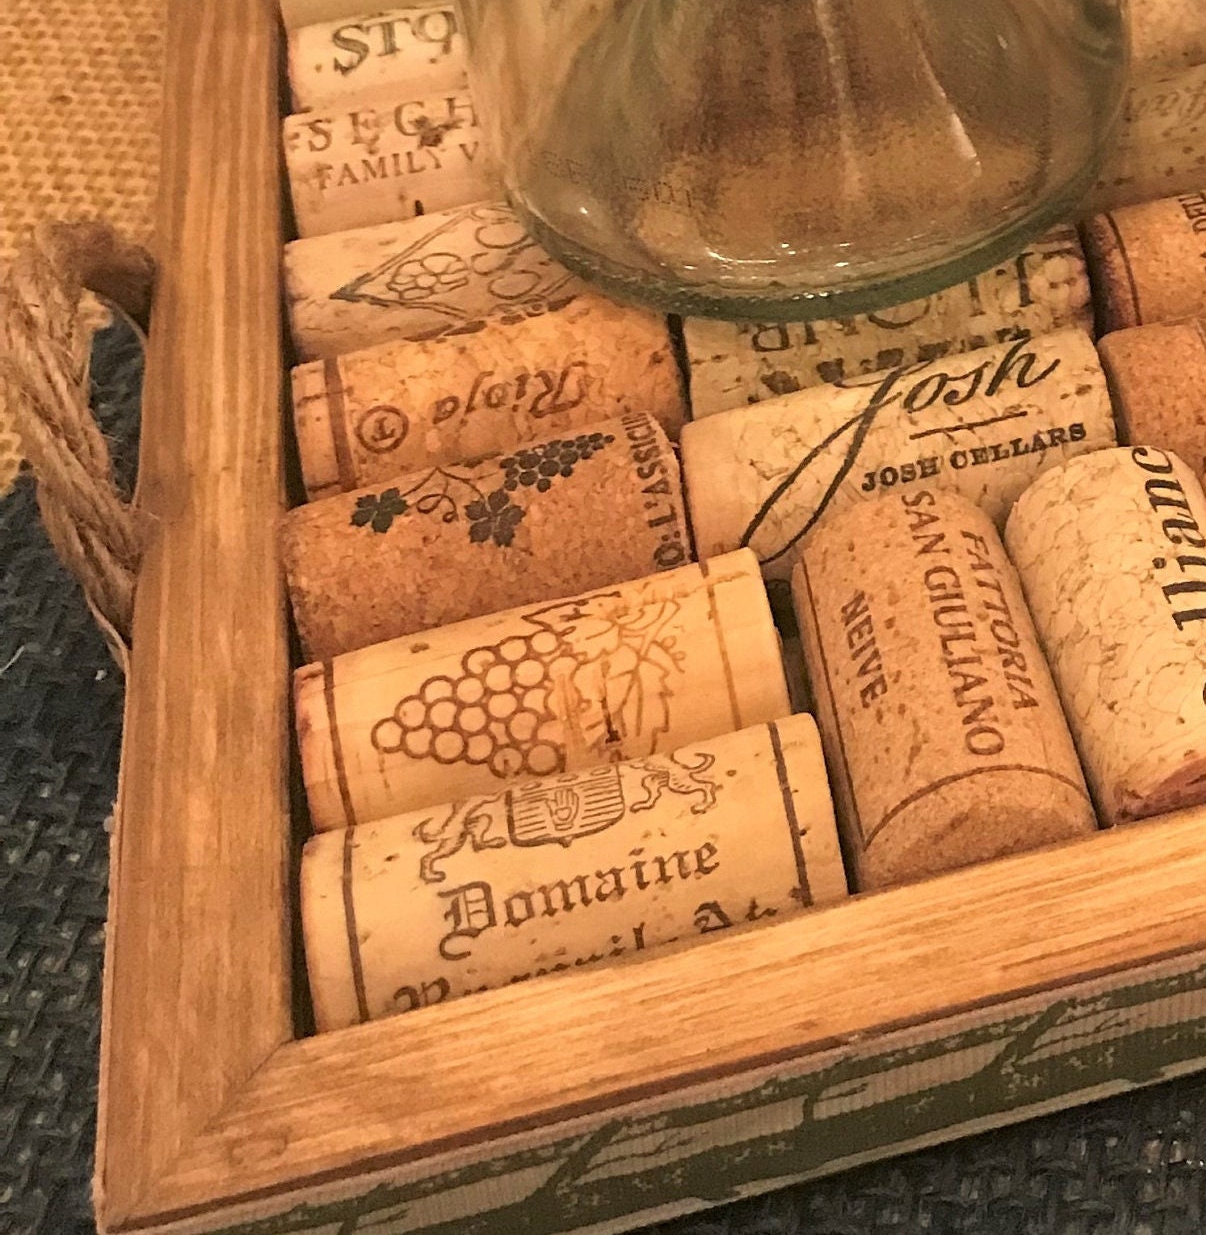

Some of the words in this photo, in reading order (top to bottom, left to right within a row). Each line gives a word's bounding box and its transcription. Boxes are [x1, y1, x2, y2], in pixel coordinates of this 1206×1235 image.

[331, 10, 459, 77] STO
[307, 96, 480, 153] SEGH
[315, 148, 443, 191] FAMILY
[432, 359, 591, 426] Rioja
[739, 335, 1061, 564] Josh
[861, 453, 943, 493] JOSH
[949, 422, 1088, 472] CELLARS
[901, 489, 951, 558] SAN
[840, 587, 889, 709] NEIVE
[960, 529, 1040, 711] FATTORIA
[923, 564, 1006, 757] GIULIANO
[436, 838, 722, 962] Domaine
